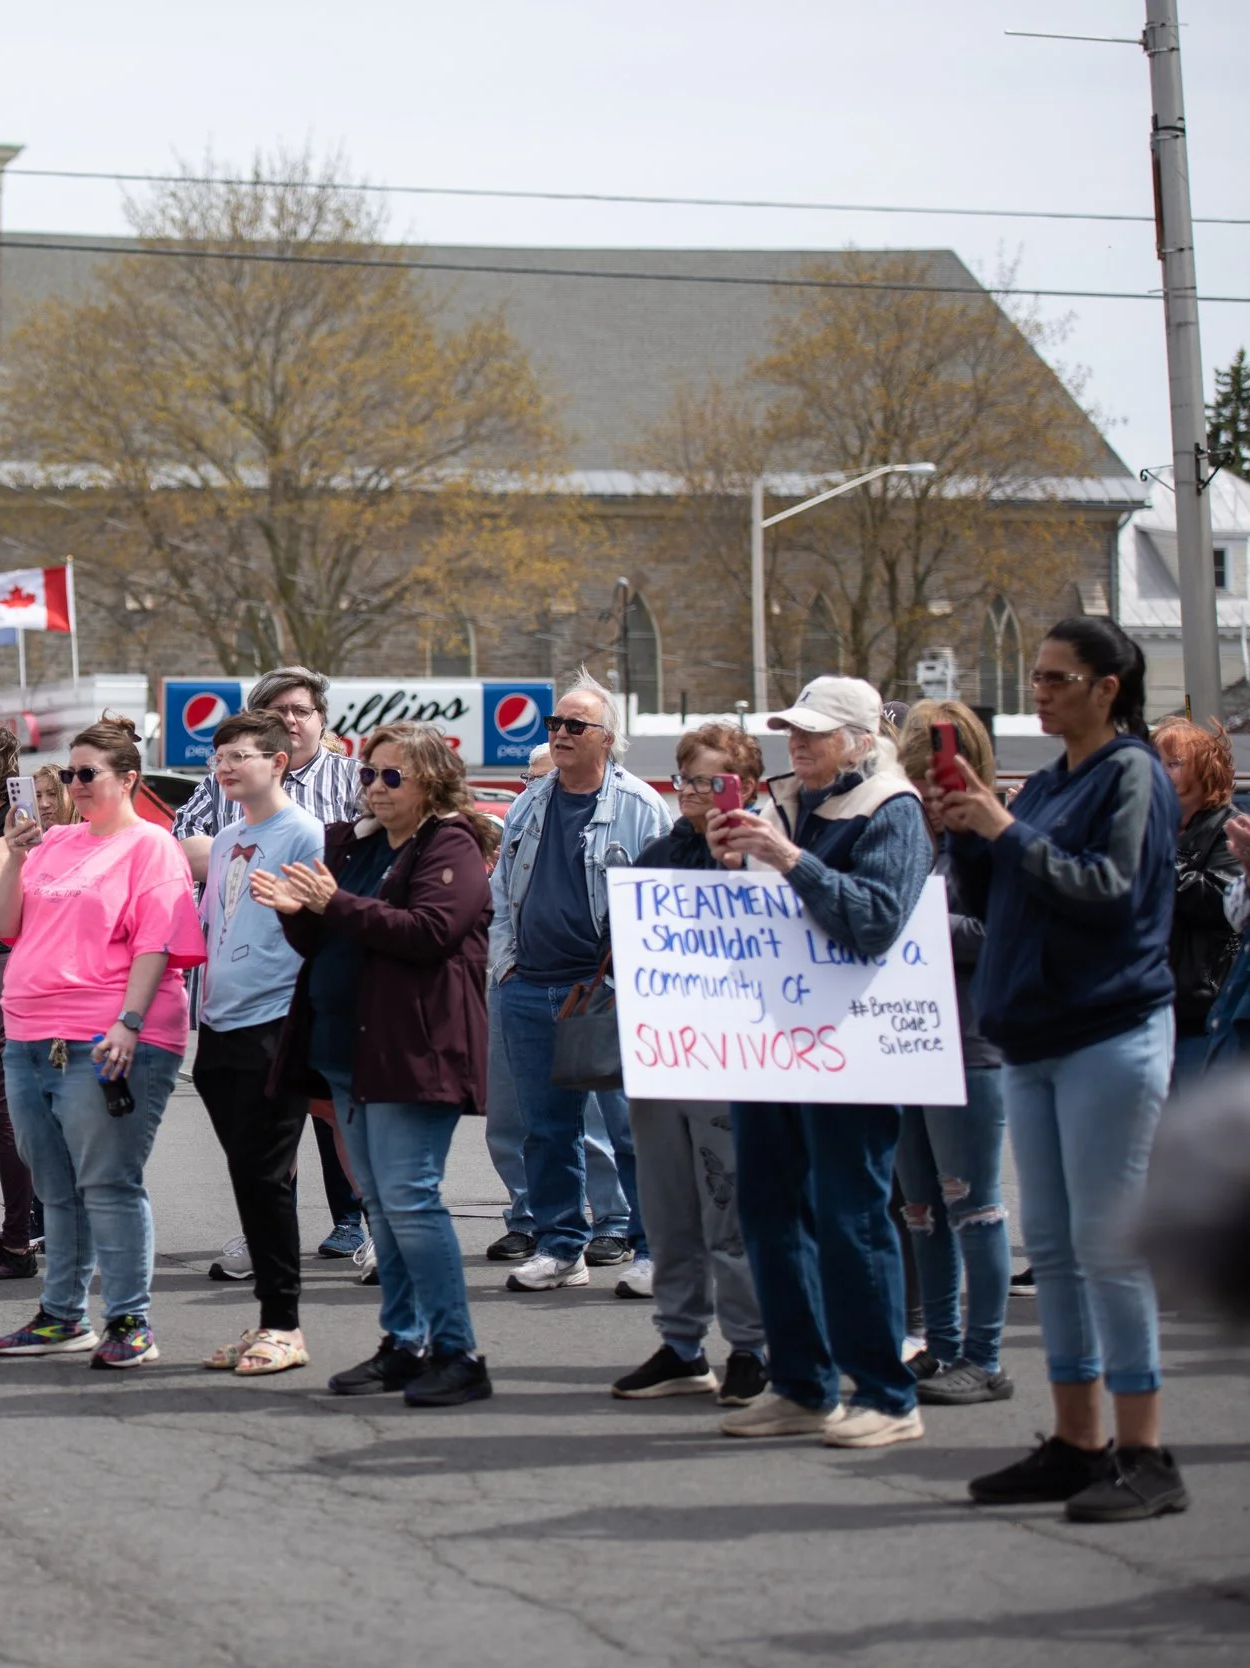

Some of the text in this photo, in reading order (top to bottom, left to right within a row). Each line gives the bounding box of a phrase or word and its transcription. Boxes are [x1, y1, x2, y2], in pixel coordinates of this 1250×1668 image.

[332, 690, 470, 736] illips
[185, 744, 215, 759] pep
[902, 940, 928, 966] a
[849, 996, 941, 1029] #Breaking
[635, 1023, 846, 1073] SURVIVORS
[879, 1035, 943, 1054] Silence
